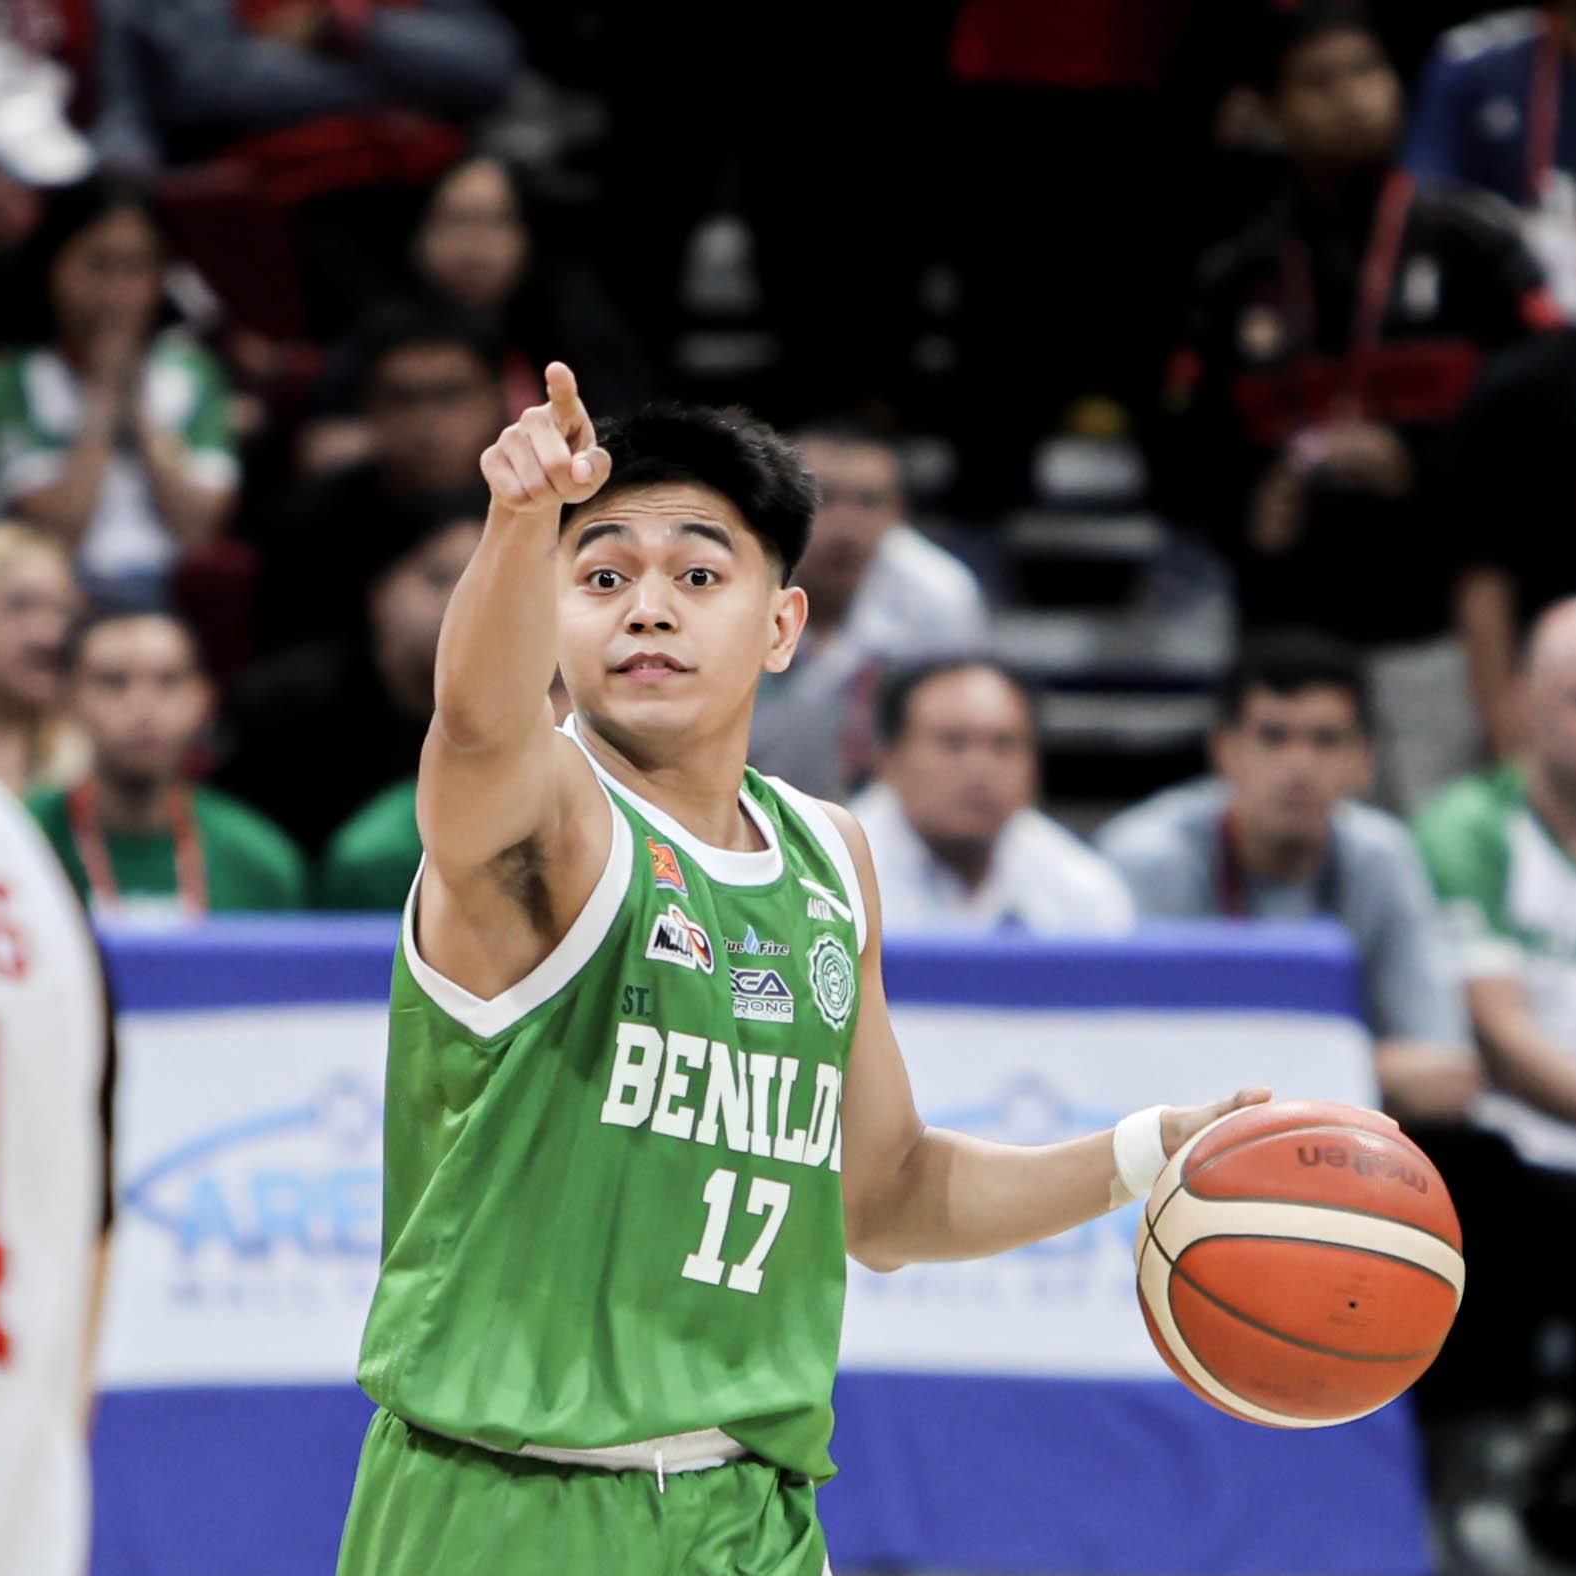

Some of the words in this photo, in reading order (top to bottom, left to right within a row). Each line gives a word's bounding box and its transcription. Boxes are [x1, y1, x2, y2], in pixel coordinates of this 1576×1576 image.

[759, 942, 790, 956] Fire
[734, 999, 793, 1014] RONG
[681, 1168, 791, 1295] 17
